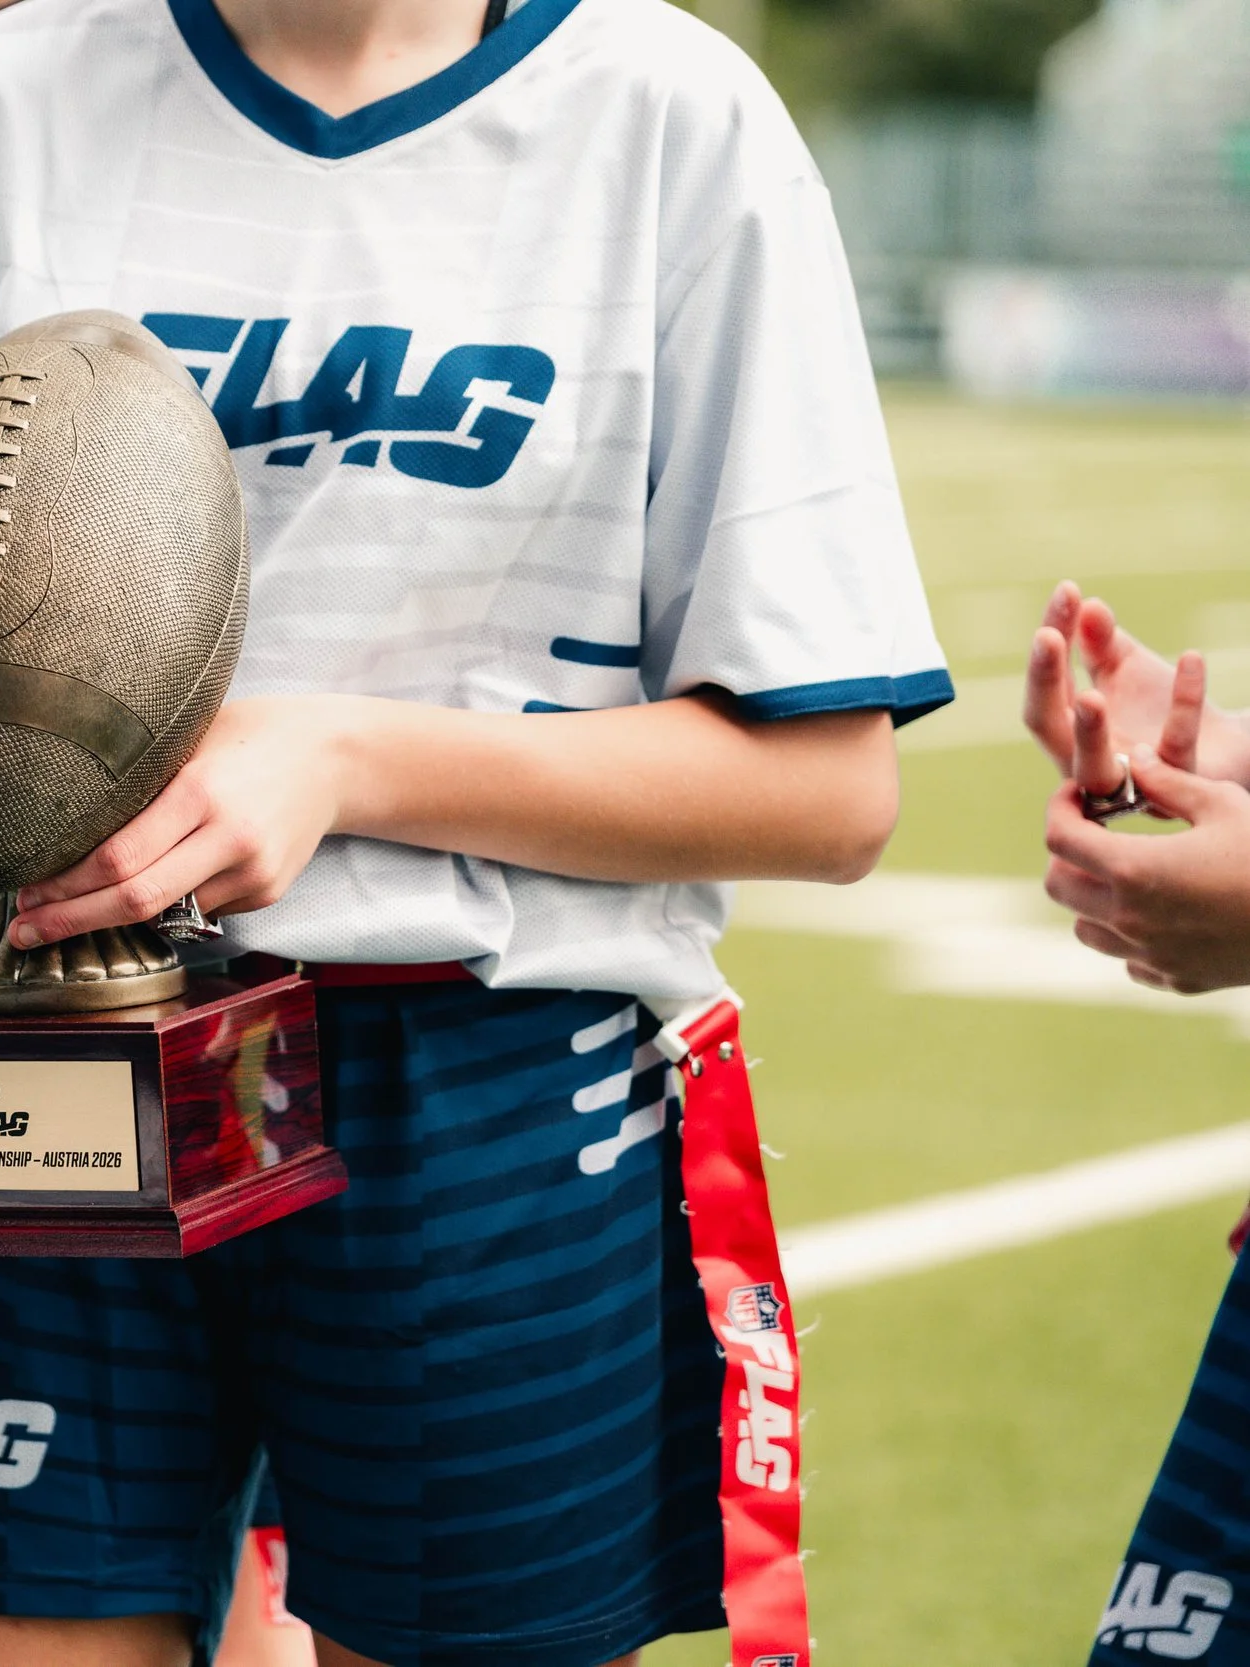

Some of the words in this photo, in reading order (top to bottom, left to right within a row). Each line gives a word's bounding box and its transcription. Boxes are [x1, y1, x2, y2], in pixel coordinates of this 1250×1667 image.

[42, 1151, 90, 1168] AUSTRIA
[91, 1151, 123, 1168] 2026
[719, 1324, 794, 1493] FLAG
[1096, 1561, 1233, 1660] AG
